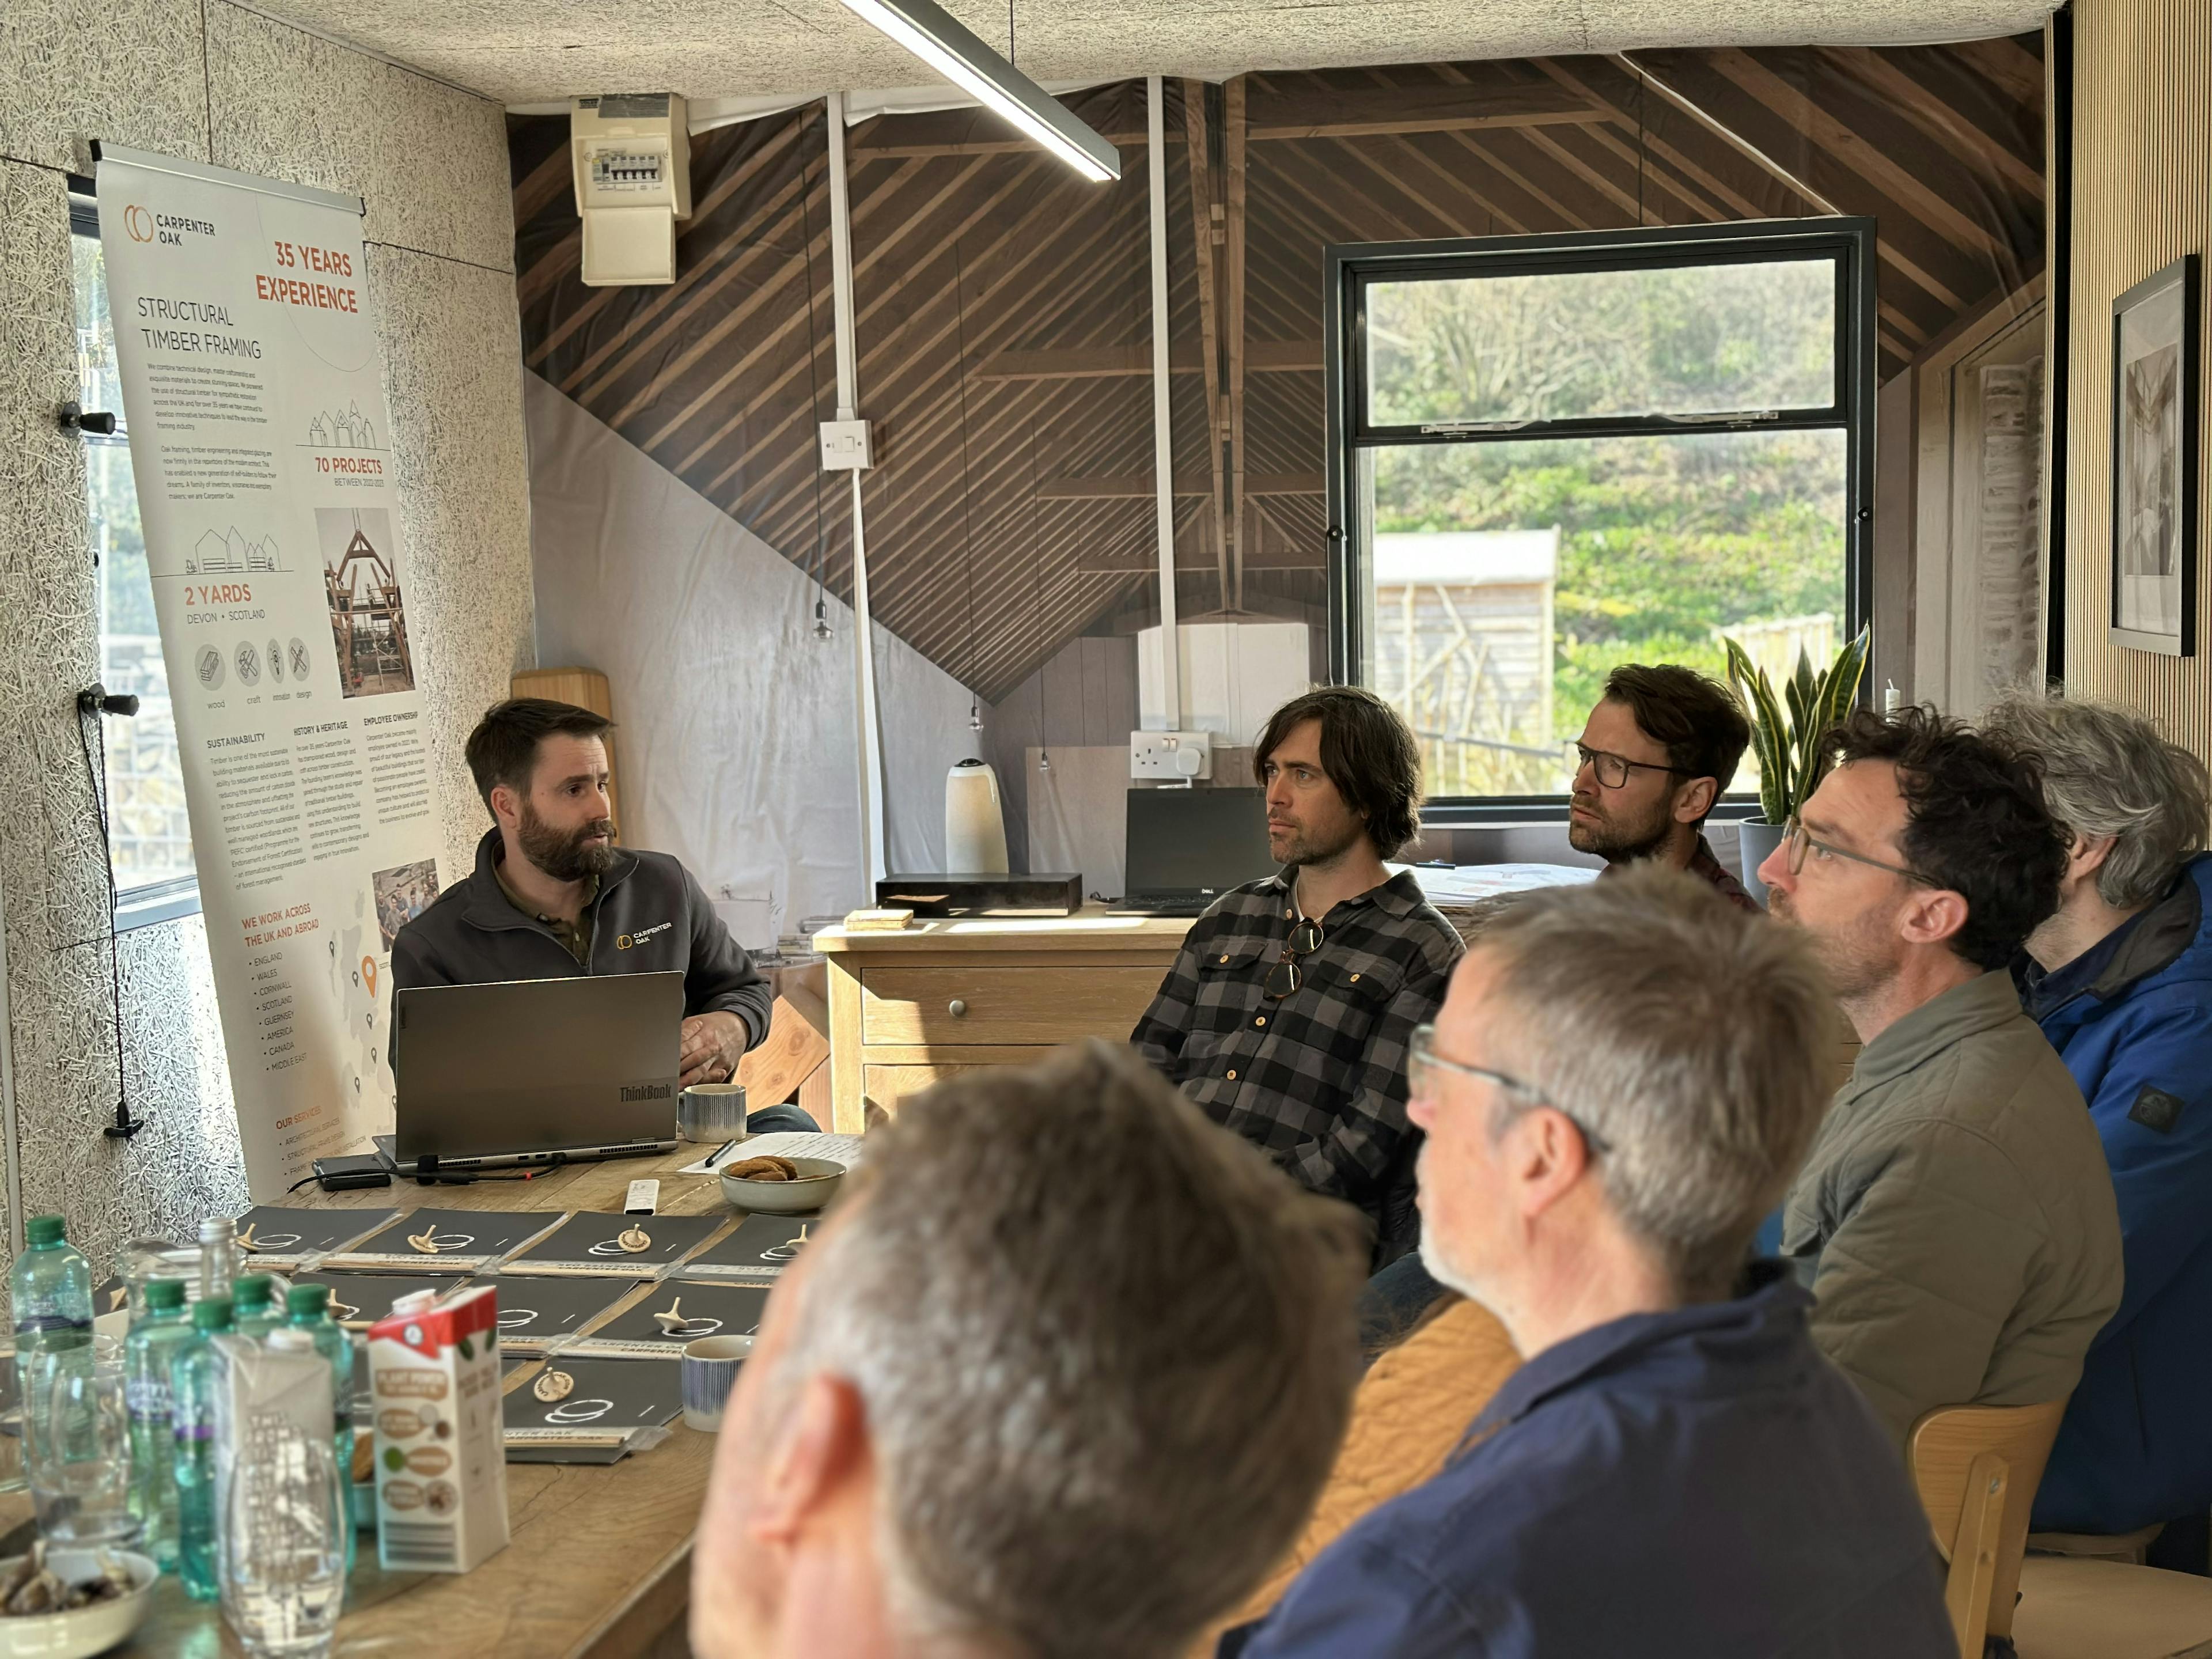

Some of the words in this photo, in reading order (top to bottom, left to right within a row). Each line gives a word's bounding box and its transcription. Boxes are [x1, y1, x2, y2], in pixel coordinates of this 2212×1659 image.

[157, 214, 215, 236] CARPENTER
[160, 230, 182, 246] OAK
[274, 241, 295, 267] 35
[298, 245, 353, 277] YEARS
[256, 275, 358, 313] EXPERIENCE
[138, 297, 234, 327] STRUCTURAL
[141, 328, 200, 352] TIMBER
[204, 334, 262, 359] FRAMING
[315, 457, 329, 472] 70
[332, 458, 382, 474] PROJECTS
[334, 478, 362, 486] BETWEEN
[184, 587, 195, 605] 2
[198, 584, 251, 604] YARDS
[187, 612, 217, 624] DEVON
[229, 609, 265, 621] SCOTLAND
[207, 700, 225, 709] wood
[247, 696, 261, 704] craft
[364, 714, 392, 726] EMPLOYEE
[393, 711, 418, 722] OWNERSHIP
[294, 725, 315, 736] HISTORY
[321, 721, 348, 732] HERITAGE
[207, 733, 265, 748] SUSTAINABILITY
[241, 918, 257, 929] WE
[258, 911, 283, 925] WORK
[285, 903, 311, 918] ACROSS
[245, 934, 261, 948] THE
[264, 931, 275, 943] UK
[277, 926, 293, 940] AND
[295, 919, 319, 934] ABROAD
[634, 922, 672, 938] CARPENTER
[636, 936, 650, 944] OAK
[254, 952, 283, 967] ENGLAND
[256, 969, 278, 980] WALES
[259, 982, 292, 996] CORNWALL
[262, 995, 293, 1011] SCOTLAND
[264, 1010, 294, 1026] GUERNSEY
[267, 1026, 293, 1041] AMERICA
[269, 1041, 295, 1055] CANADA
[271, 1058, 295, 1071] MIDDLE
[295, 1052, 308, 1064] EAST
[620, 1084, 672, 1103] ThinkBook
[276, 1117, 293, 1130] OUR
[294, 1105, 322, 1123] SERVICES
